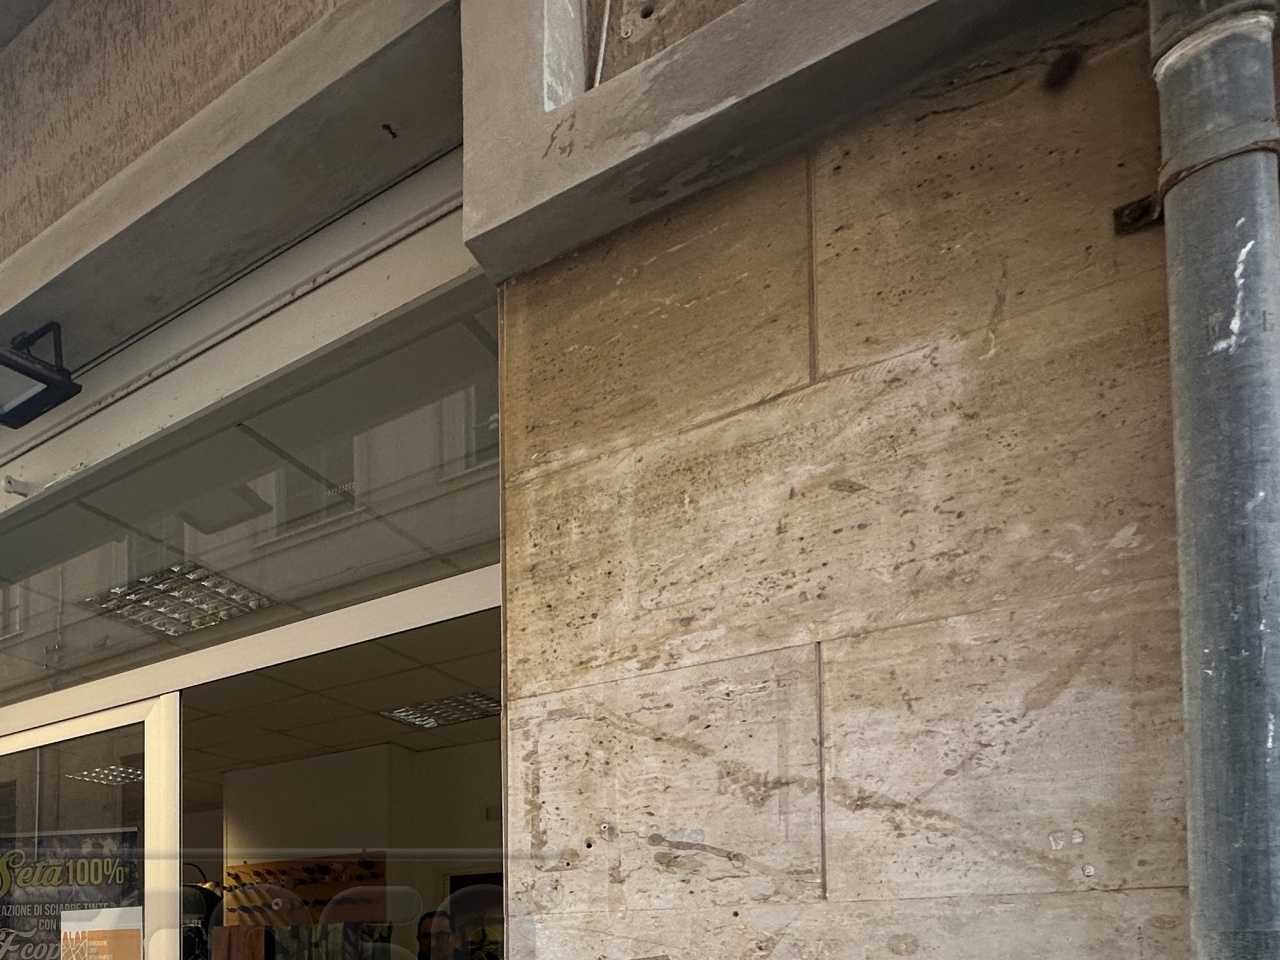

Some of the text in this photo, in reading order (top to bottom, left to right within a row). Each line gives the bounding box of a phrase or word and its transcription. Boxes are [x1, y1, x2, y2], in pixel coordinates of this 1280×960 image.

[66, 857, 125, 885] 100%
[34, 904, 43, 916] DI
[38, 919, 56, 931] CON
